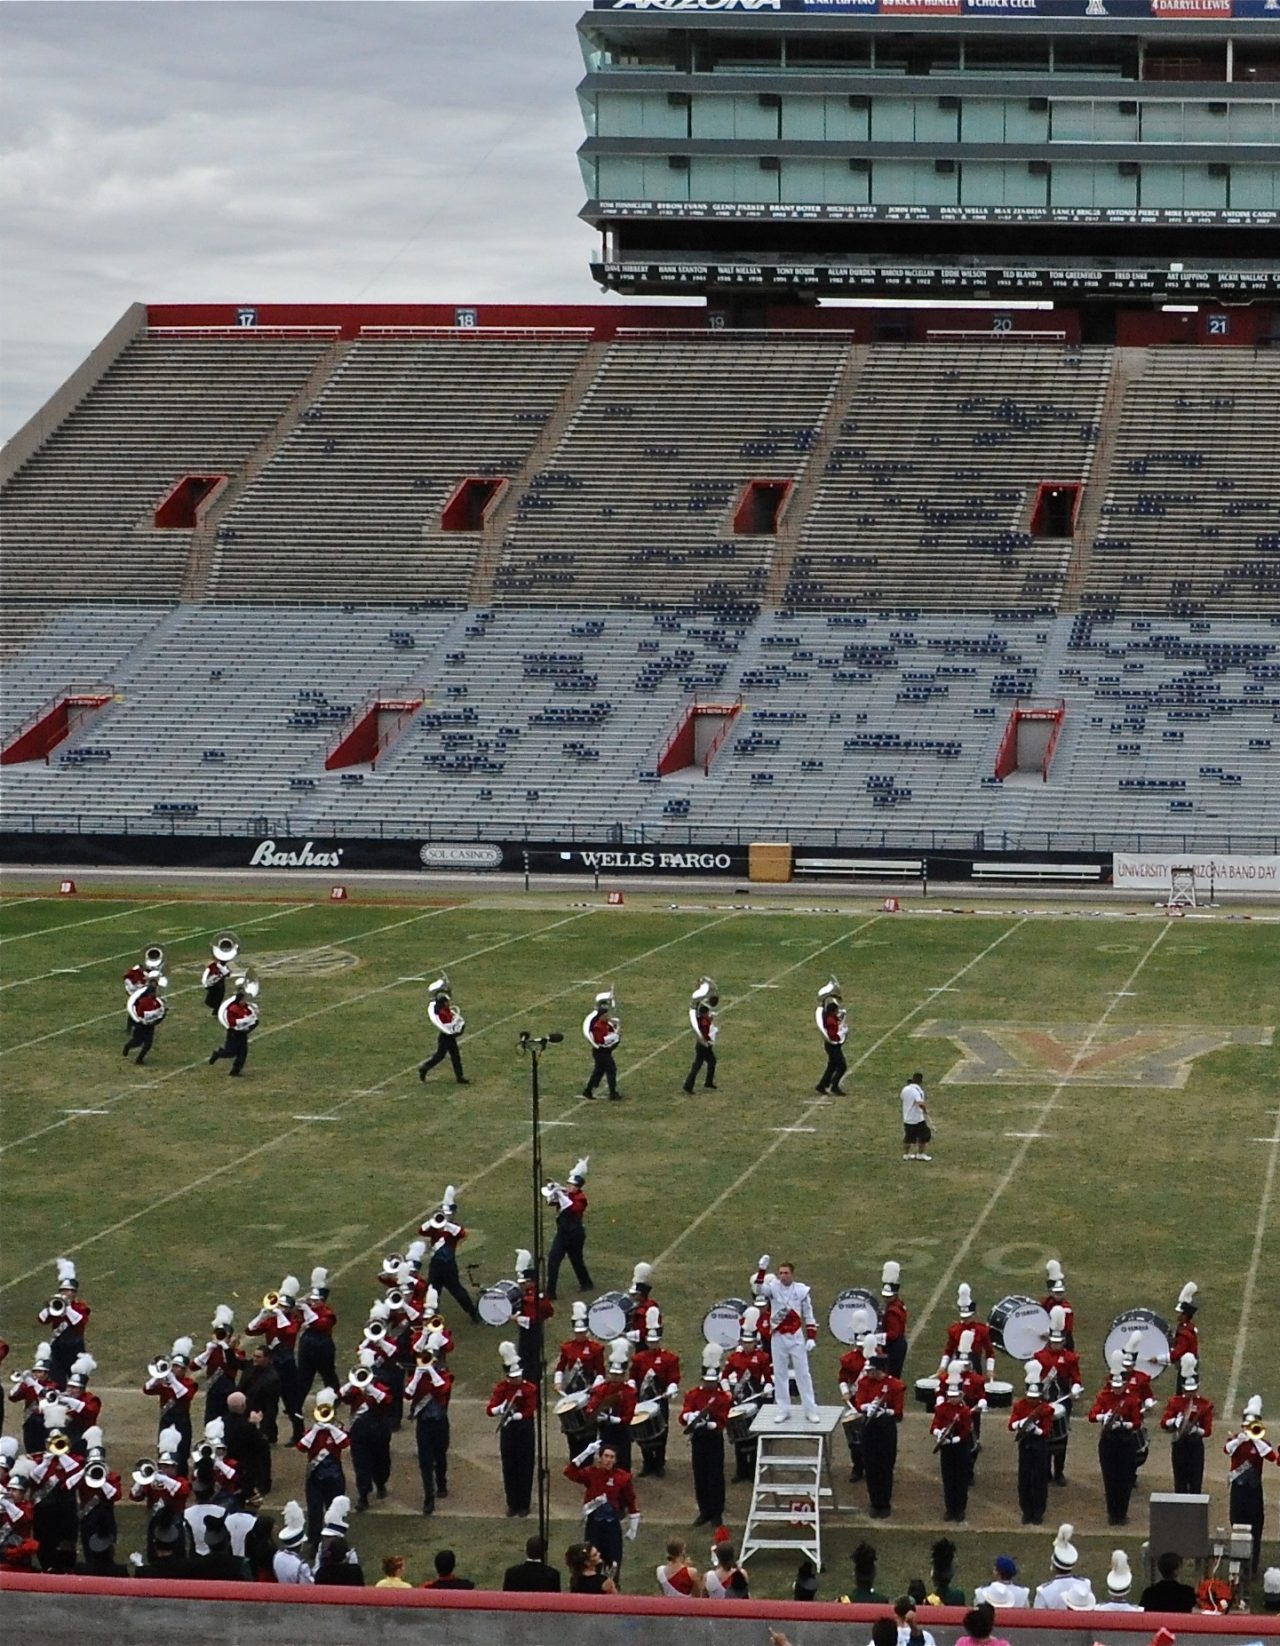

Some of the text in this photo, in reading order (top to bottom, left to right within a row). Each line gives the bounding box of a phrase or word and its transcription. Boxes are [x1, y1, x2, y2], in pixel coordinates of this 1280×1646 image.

[975, 0, 1008, 8] CHUCK
[1010, 0, 1037, 8] CECIL
[1152, 0, 1231, 10] 4 DARRYLL LEWIS
[239, 314, 254, 327] 17
[457, 314, 474, 327] 18
[709, 316, 725, 329] 19
[993, 319, 1012, 331] 20
[1210, 320, 1226, 334] 21
[249, 840, 343, 867] Bashas'
[429, 848, 494, 859] SOL CASINOS
[580, 852, 731, 868] WELLS FARGO
[1118, 863, 1168, 878] UNIVERSITY
[1229, 865, 1256, 879] BAND
[1258, 866, 1277, 880] DAY
